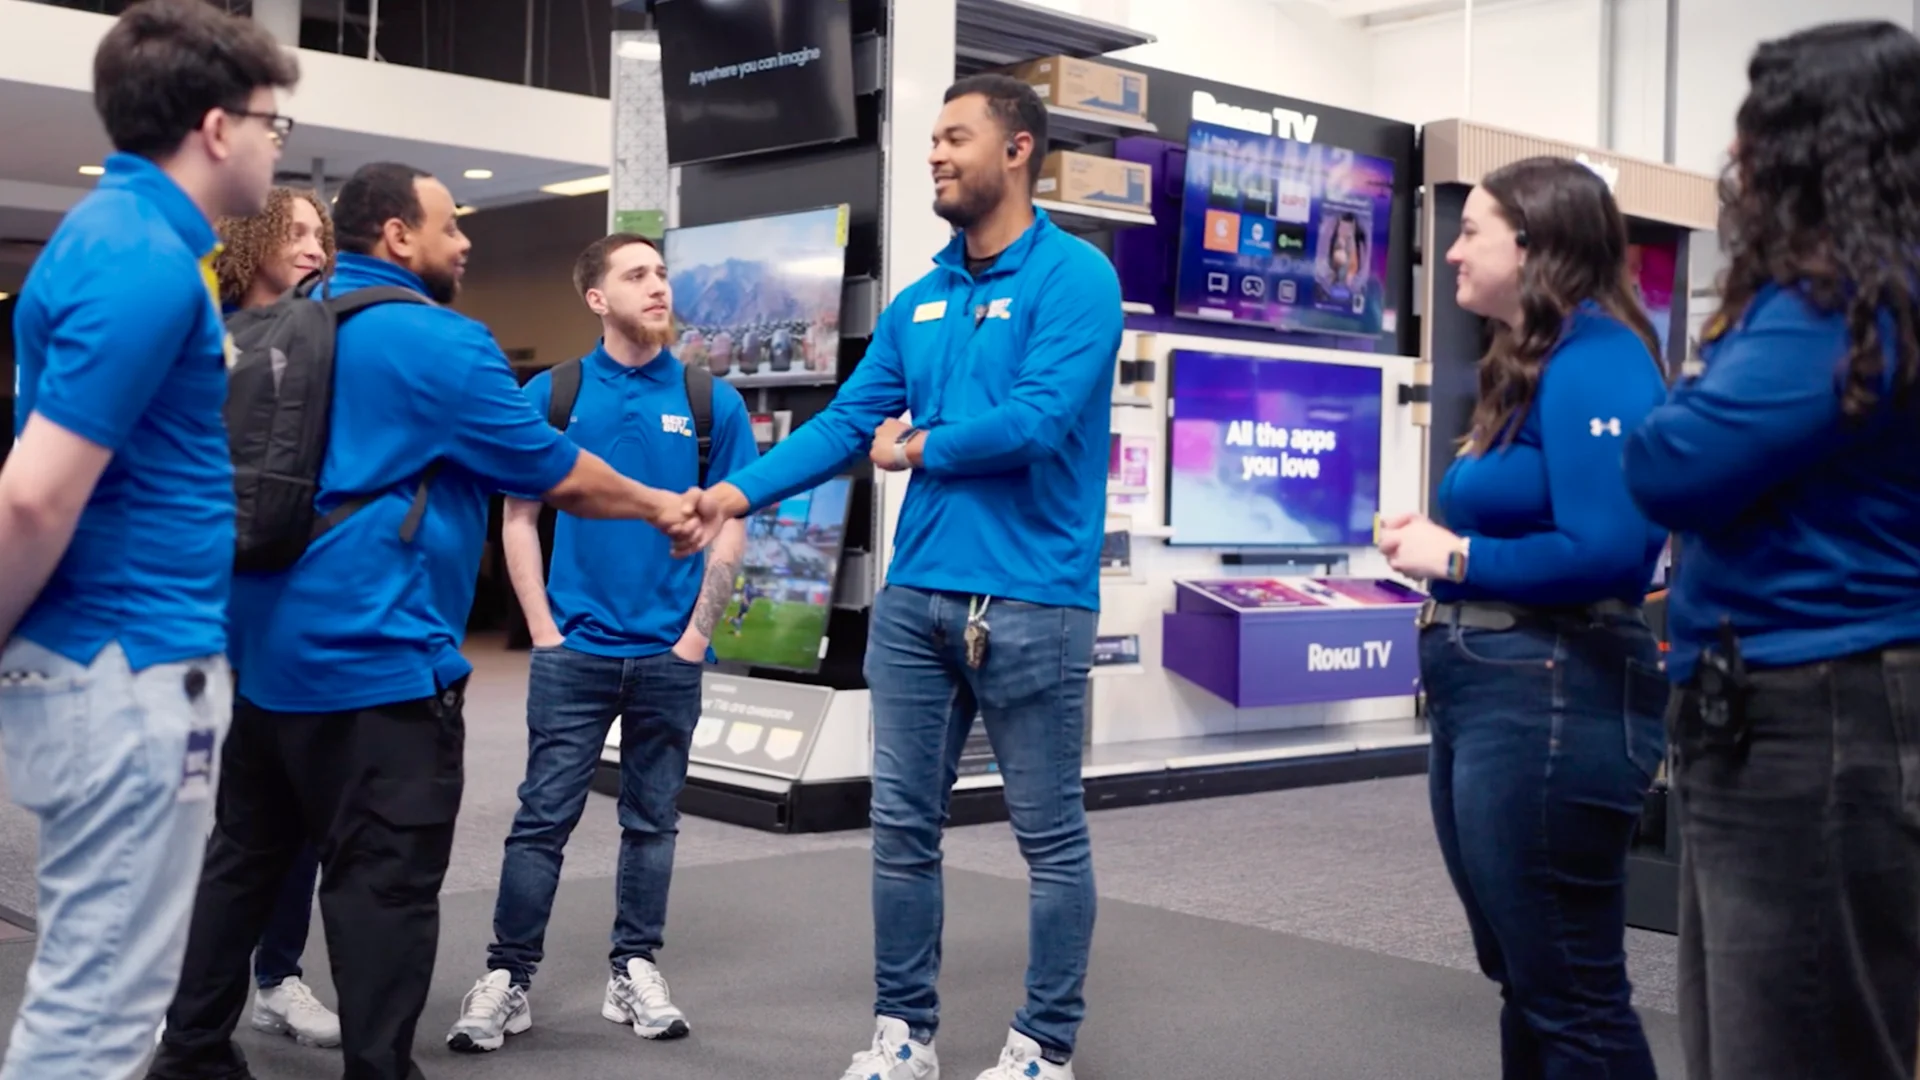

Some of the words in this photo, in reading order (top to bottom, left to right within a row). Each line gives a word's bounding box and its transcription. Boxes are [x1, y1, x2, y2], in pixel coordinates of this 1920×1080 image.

[690, 65, 738, 86] Anywhere
[739, 61, 757, 78] you
[758, 57, 778, 70] can
[778, 47, 820, 66] imagine
[1272, 107, 1318, 143] TV
[1226, 420, 1254, 446] All
[1256, 422, 1288, 448] the
[1290, 428, 1336, 454] apps
[1242, 456, 1278, 480] you
[1281, 452, 1320, 478] love
[1363, 640, 1393, 668] TV
